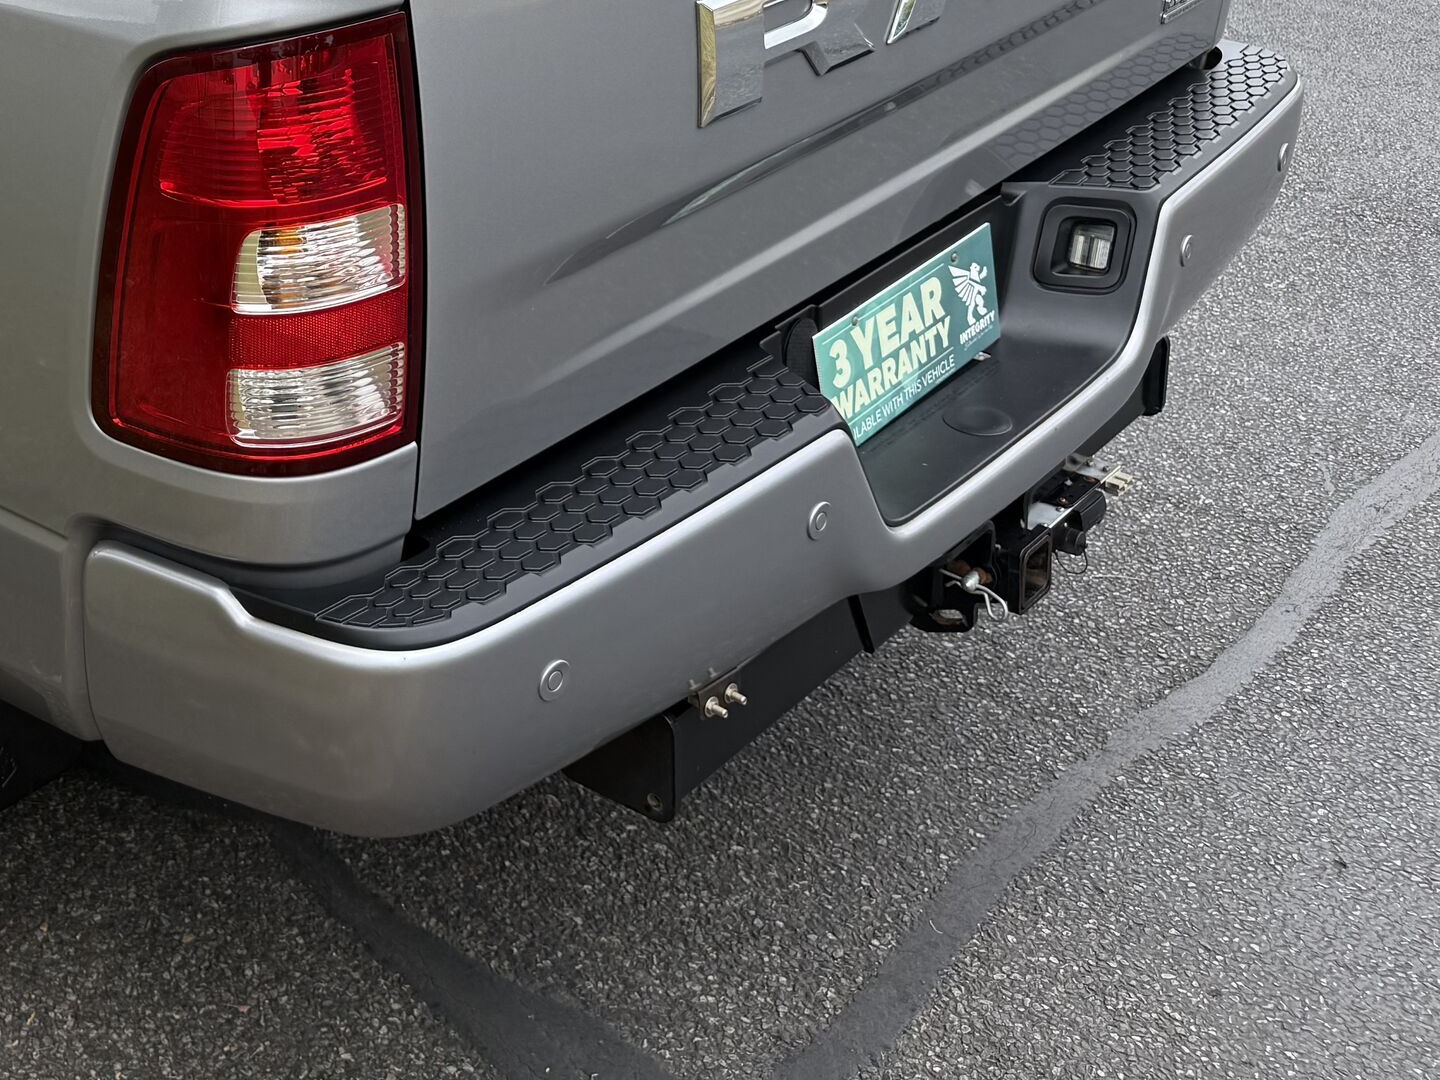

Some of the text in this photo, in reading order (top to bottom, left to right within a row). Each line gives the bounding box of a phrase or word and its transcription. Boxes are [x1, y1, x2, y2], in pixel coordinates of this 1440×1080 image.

[829, 277, 947, 388] 3 YEAR
[831, 315, 951, 420] WARRANTY
[959, 310, 995, 345] INTEGRITY
[853, 410, 882, 440] ILABLE
[880, 391, 904, 417] WITH
[903, 377, 923, 400] THIS
[922, 353, 956, 388] VEHICLE
